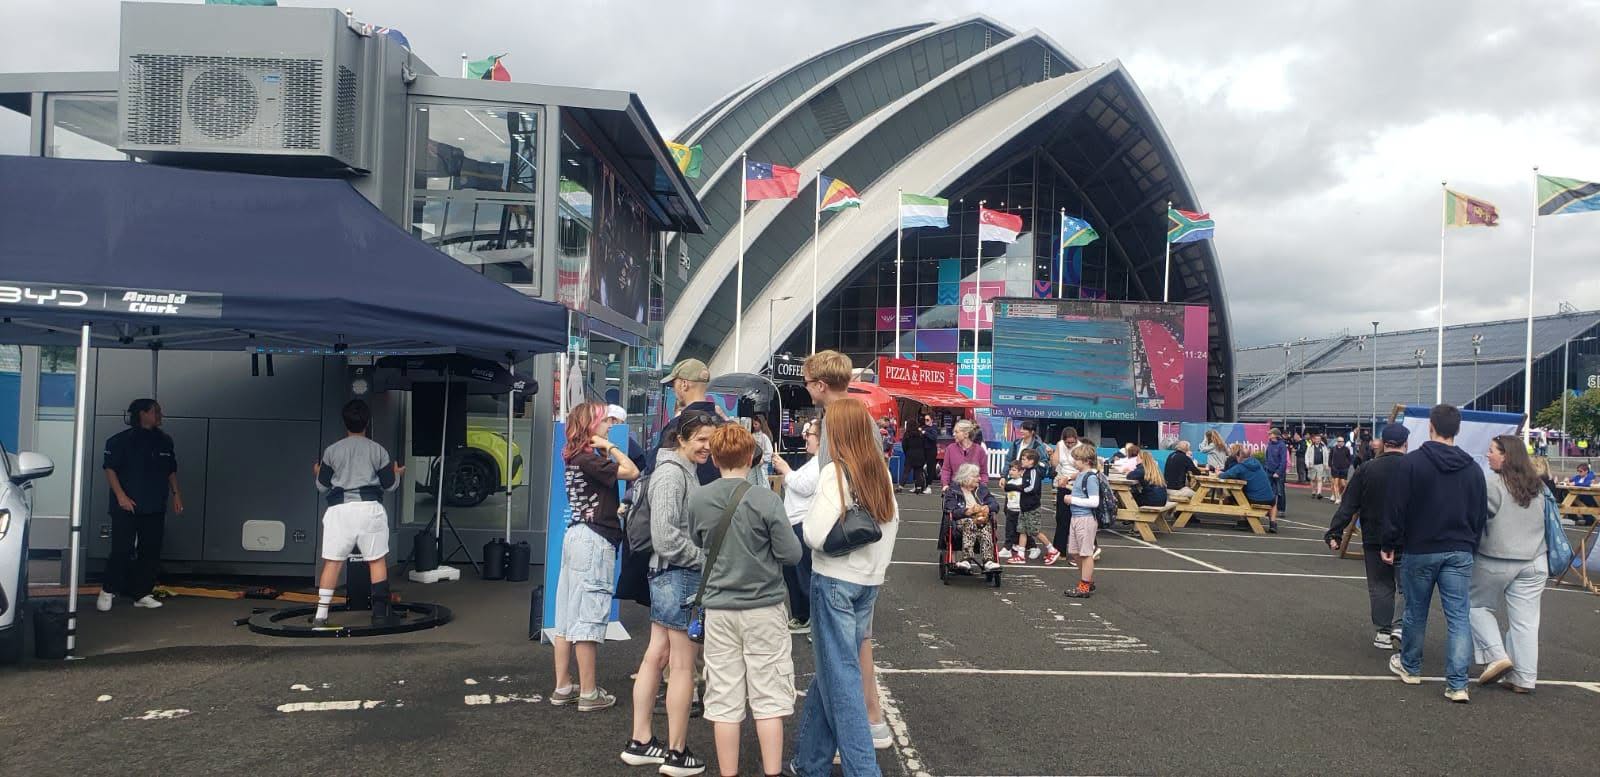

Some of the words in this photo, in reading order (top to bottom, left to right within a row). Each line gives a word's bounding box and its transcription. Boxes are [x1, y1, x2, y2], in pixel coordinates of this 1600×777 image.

[0, 286, 88, 307] BYD
[122, 291, 188, 304] Arnold
[128, 302, 179, 314] Clark
[1184, 351, 1208, 359] 11:24
[885, 365, 911, 381] PIZZA
[911, 369, 918, 381] &
[919, 369, 945, 384] FRIES
[1007, 407, 1022, 416] We
[1024, 408, 1045, 418] hope
[1047, 410, 1063, 419] you
[1064, 410, 1088, 419] enjoy
[1089, 410, 1103, 418] the
[1105, 410, 1138, 420] Games!
